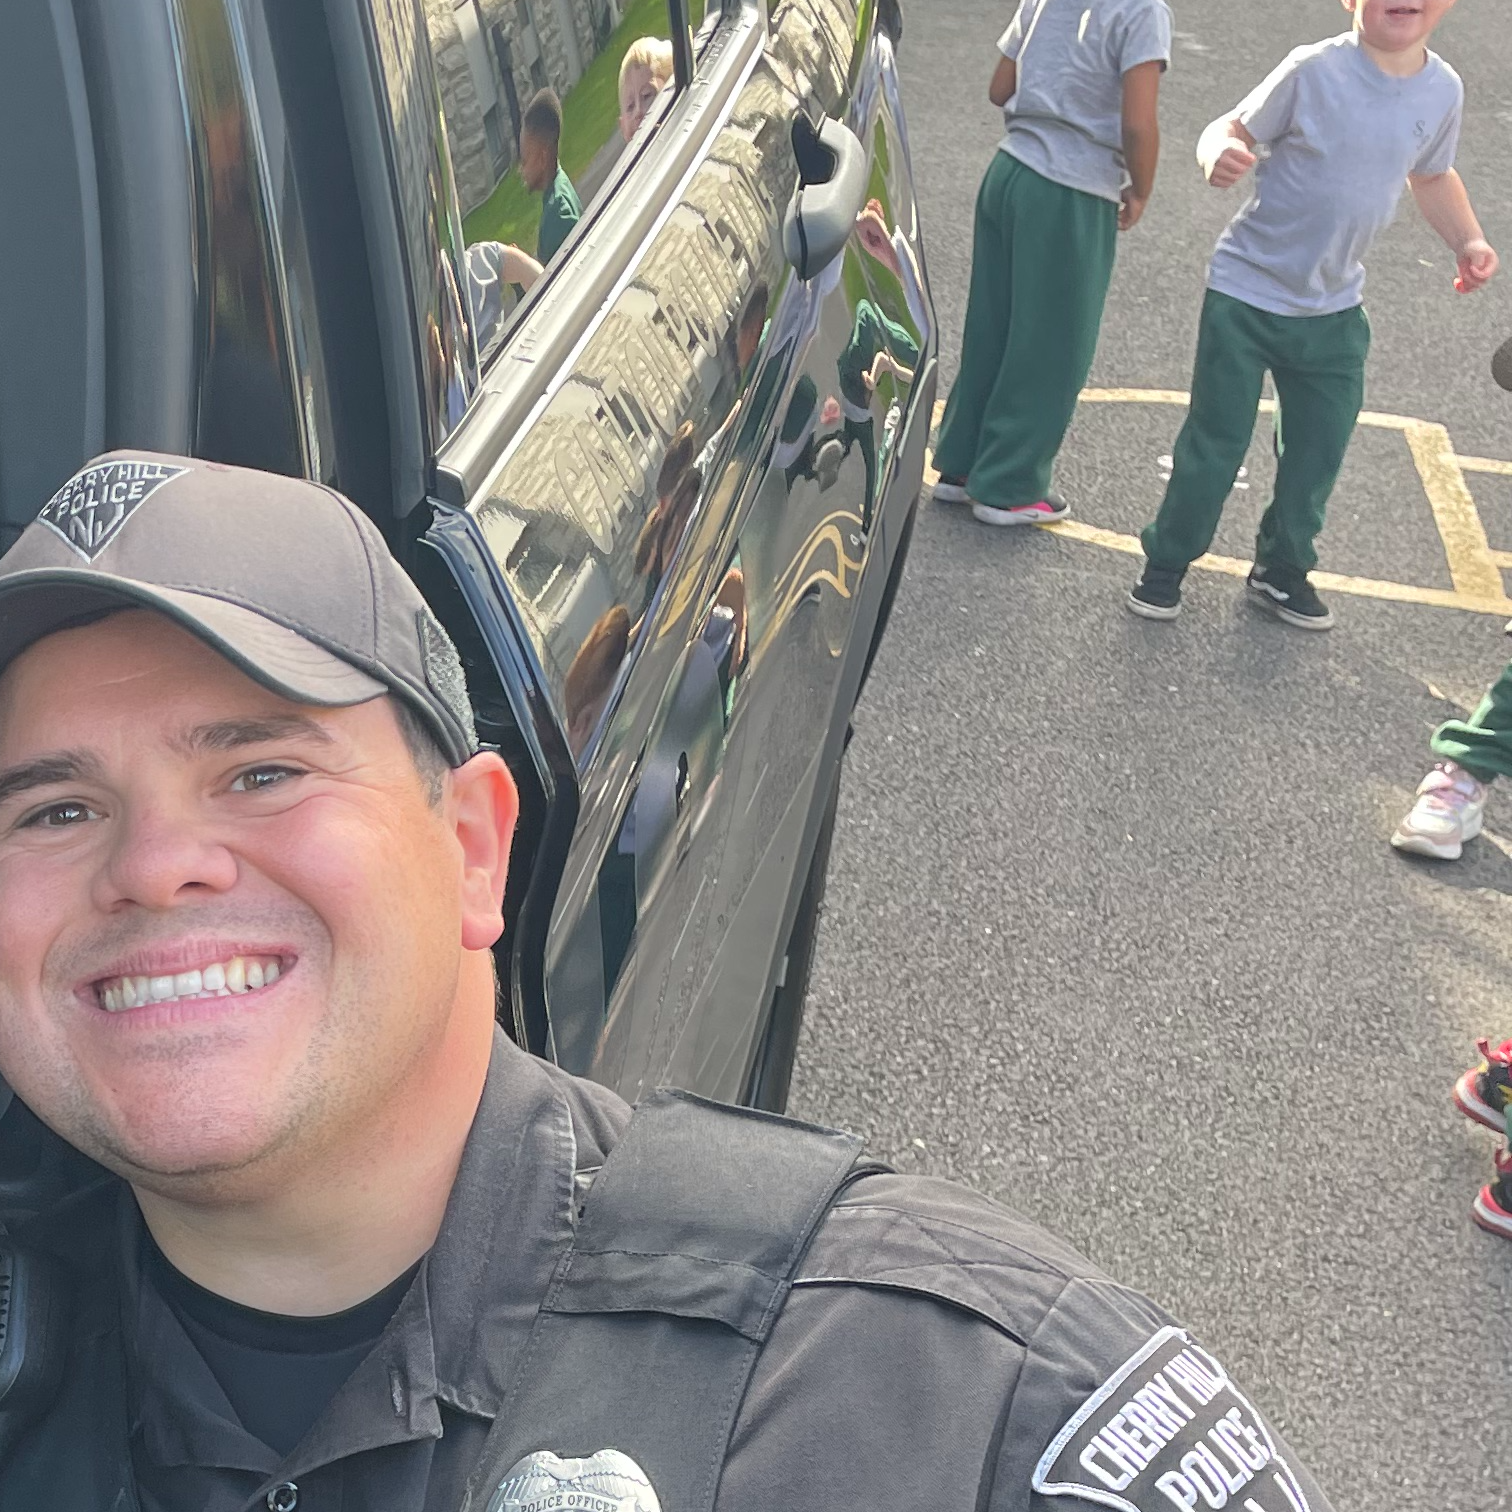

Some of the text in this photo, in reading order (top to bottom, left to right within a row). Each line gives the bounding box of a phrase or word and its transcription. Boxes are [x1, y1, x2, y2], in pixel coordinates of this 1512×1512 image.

[654, 205, 752, 383] POLICE
[118, 463, 169, 480] HILL
[57, 480, 146, 522] POLICE
[69, 503, 125, 547] NJ
[1079, 1348, 1226, 1491] CHERRY HILL
